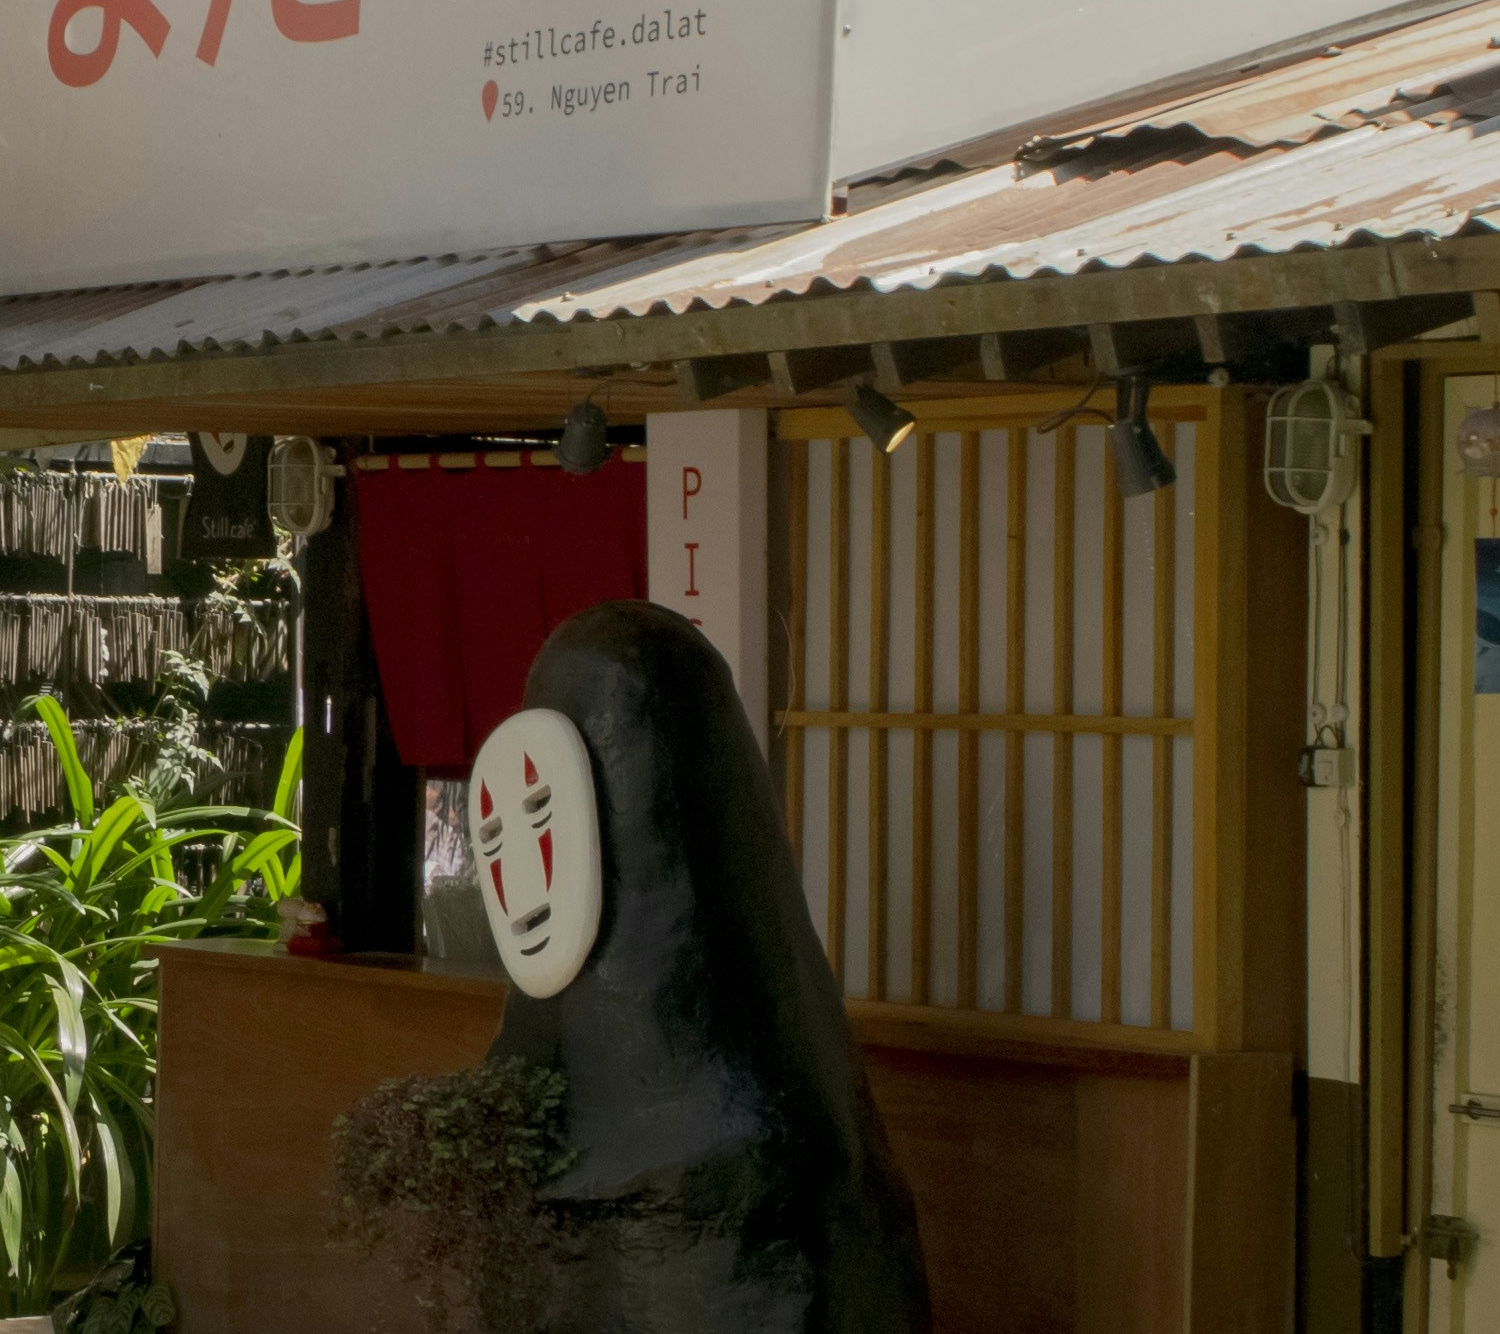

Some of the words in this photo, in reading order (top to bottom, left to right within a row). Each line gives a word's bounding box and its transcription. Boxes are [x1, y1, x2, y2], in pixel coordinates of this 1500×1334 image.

[483, 8, 707, 69] #stillcafe.dalat
[550, 77, 631, 116] Nguyen
[647, 67, 703, 100] Trai
[201, 516, 229, 539] Still
[682, 466, 702, 627] PI
